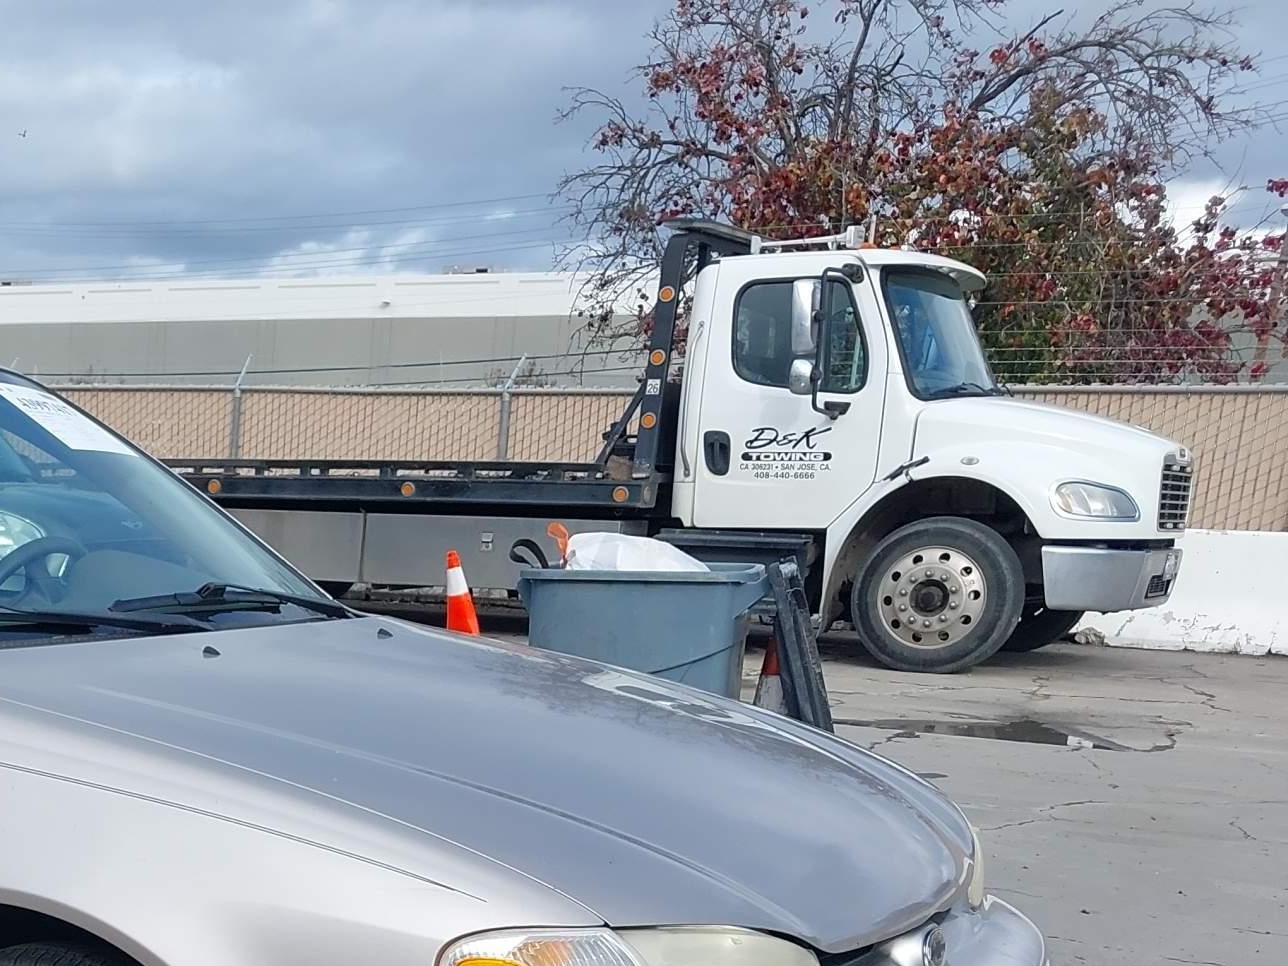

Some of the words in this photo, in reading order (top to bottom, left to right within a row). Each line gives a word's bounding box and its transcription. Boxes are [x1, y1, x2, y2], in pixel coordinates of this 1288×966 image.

[648, 383, 659, 394] 26
[745, 427, 832, 449] D&K
[749, 453, 824, 462] TOWING
[739, 463, 749, 471] CA
[780, 463, 795, 471] SAN
[753, 471, 815, 480] 408-440-6666
